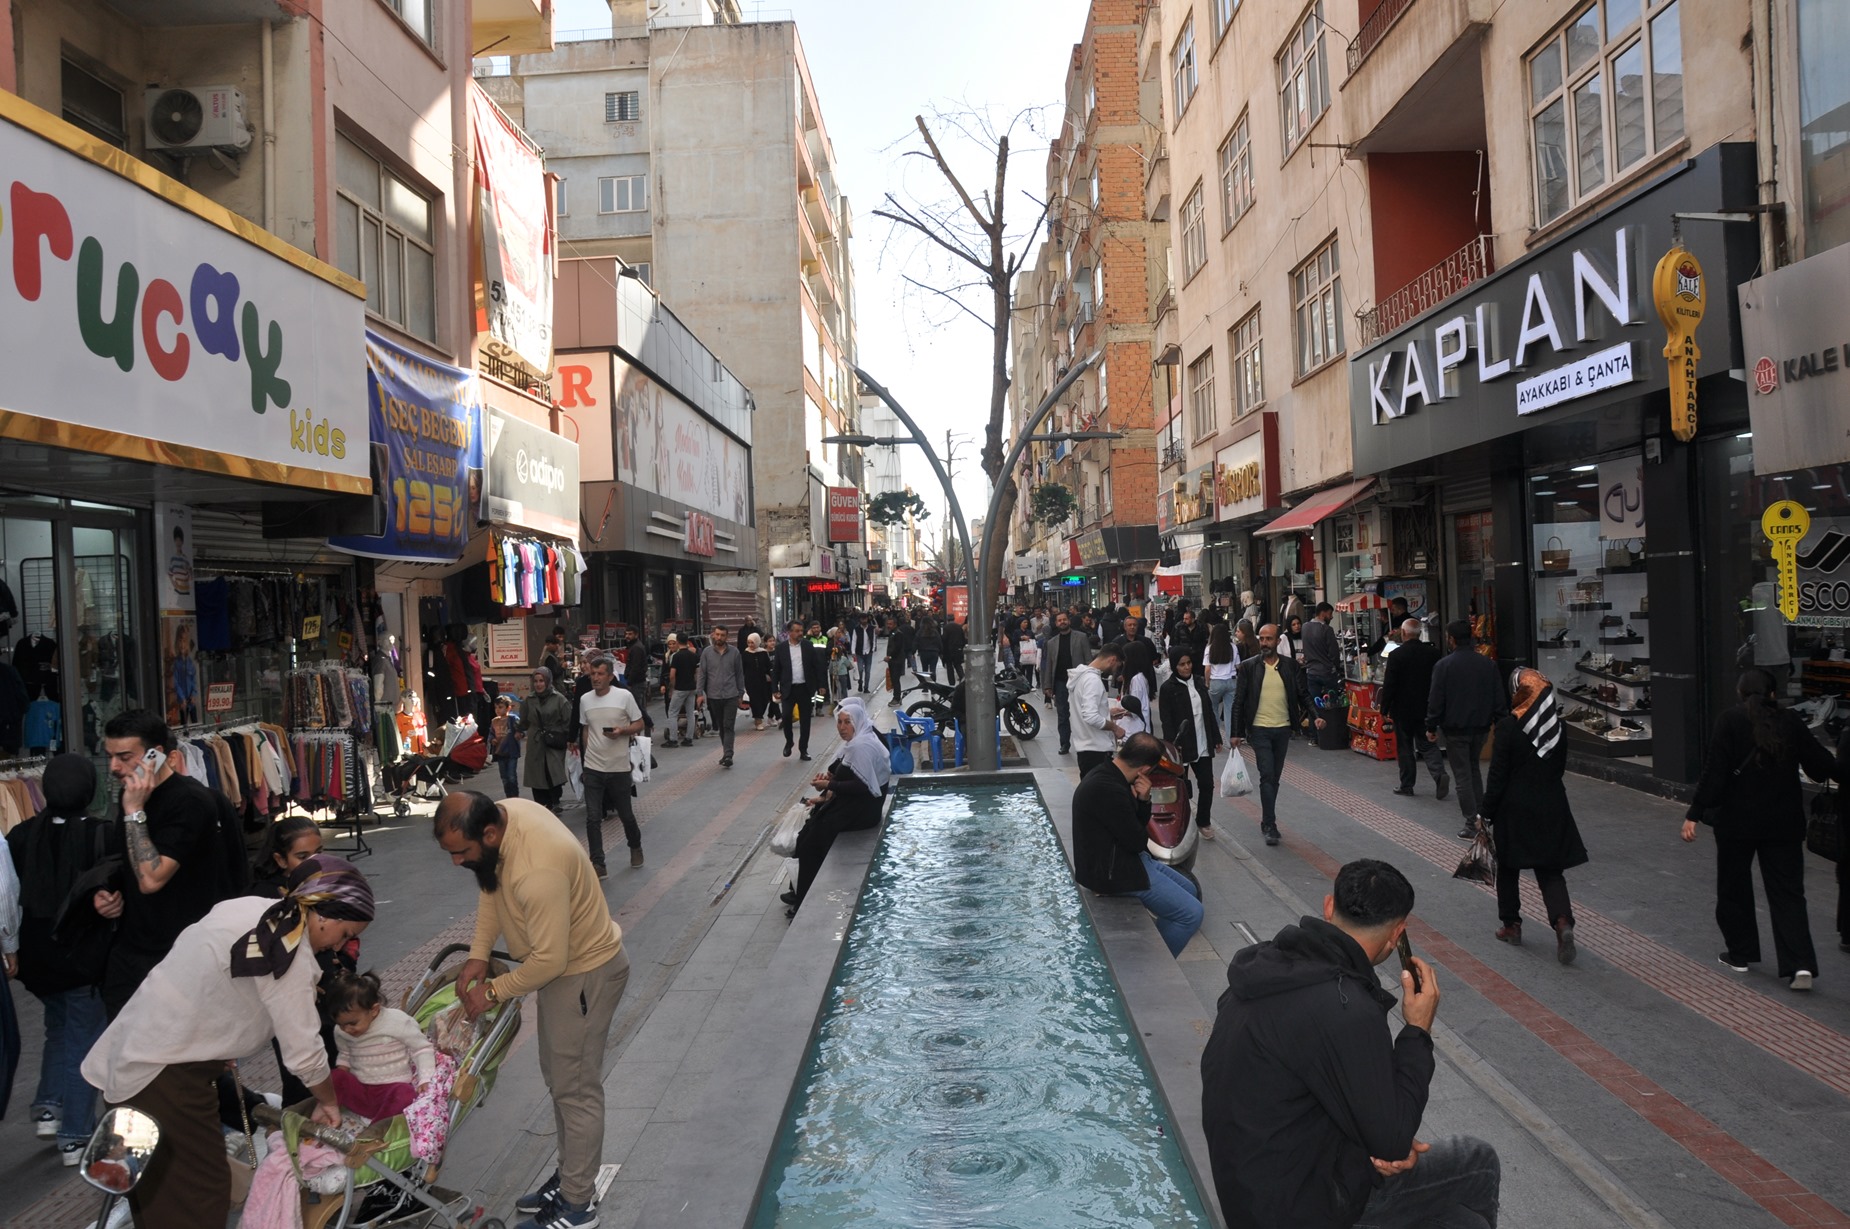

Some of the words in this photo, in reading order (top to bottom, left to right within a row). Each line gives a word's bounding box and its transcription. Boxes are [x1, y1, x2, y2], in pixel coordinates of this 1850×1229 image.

[0, 181, 292, 414] rucak
[1677, 272, 1700, 297] KALE
[1368, 227, 1630, 426] KAPLAN
[1519, 378, 1572, 407] AYAKKABI
[1575, 370, 1584, 387] &
[1587, 354, 1631, 388] ÇANTA
[1685, 335, 1697, 436] ANAHTARCI
[1783, 346, 1838, 383] KALE
[290, 408, 346, 459] kids
[388, 397, 419, 440] SEÇ
[420, 406, 467, 449] BEĞEN
[530, 456, 565, 494] adipro
